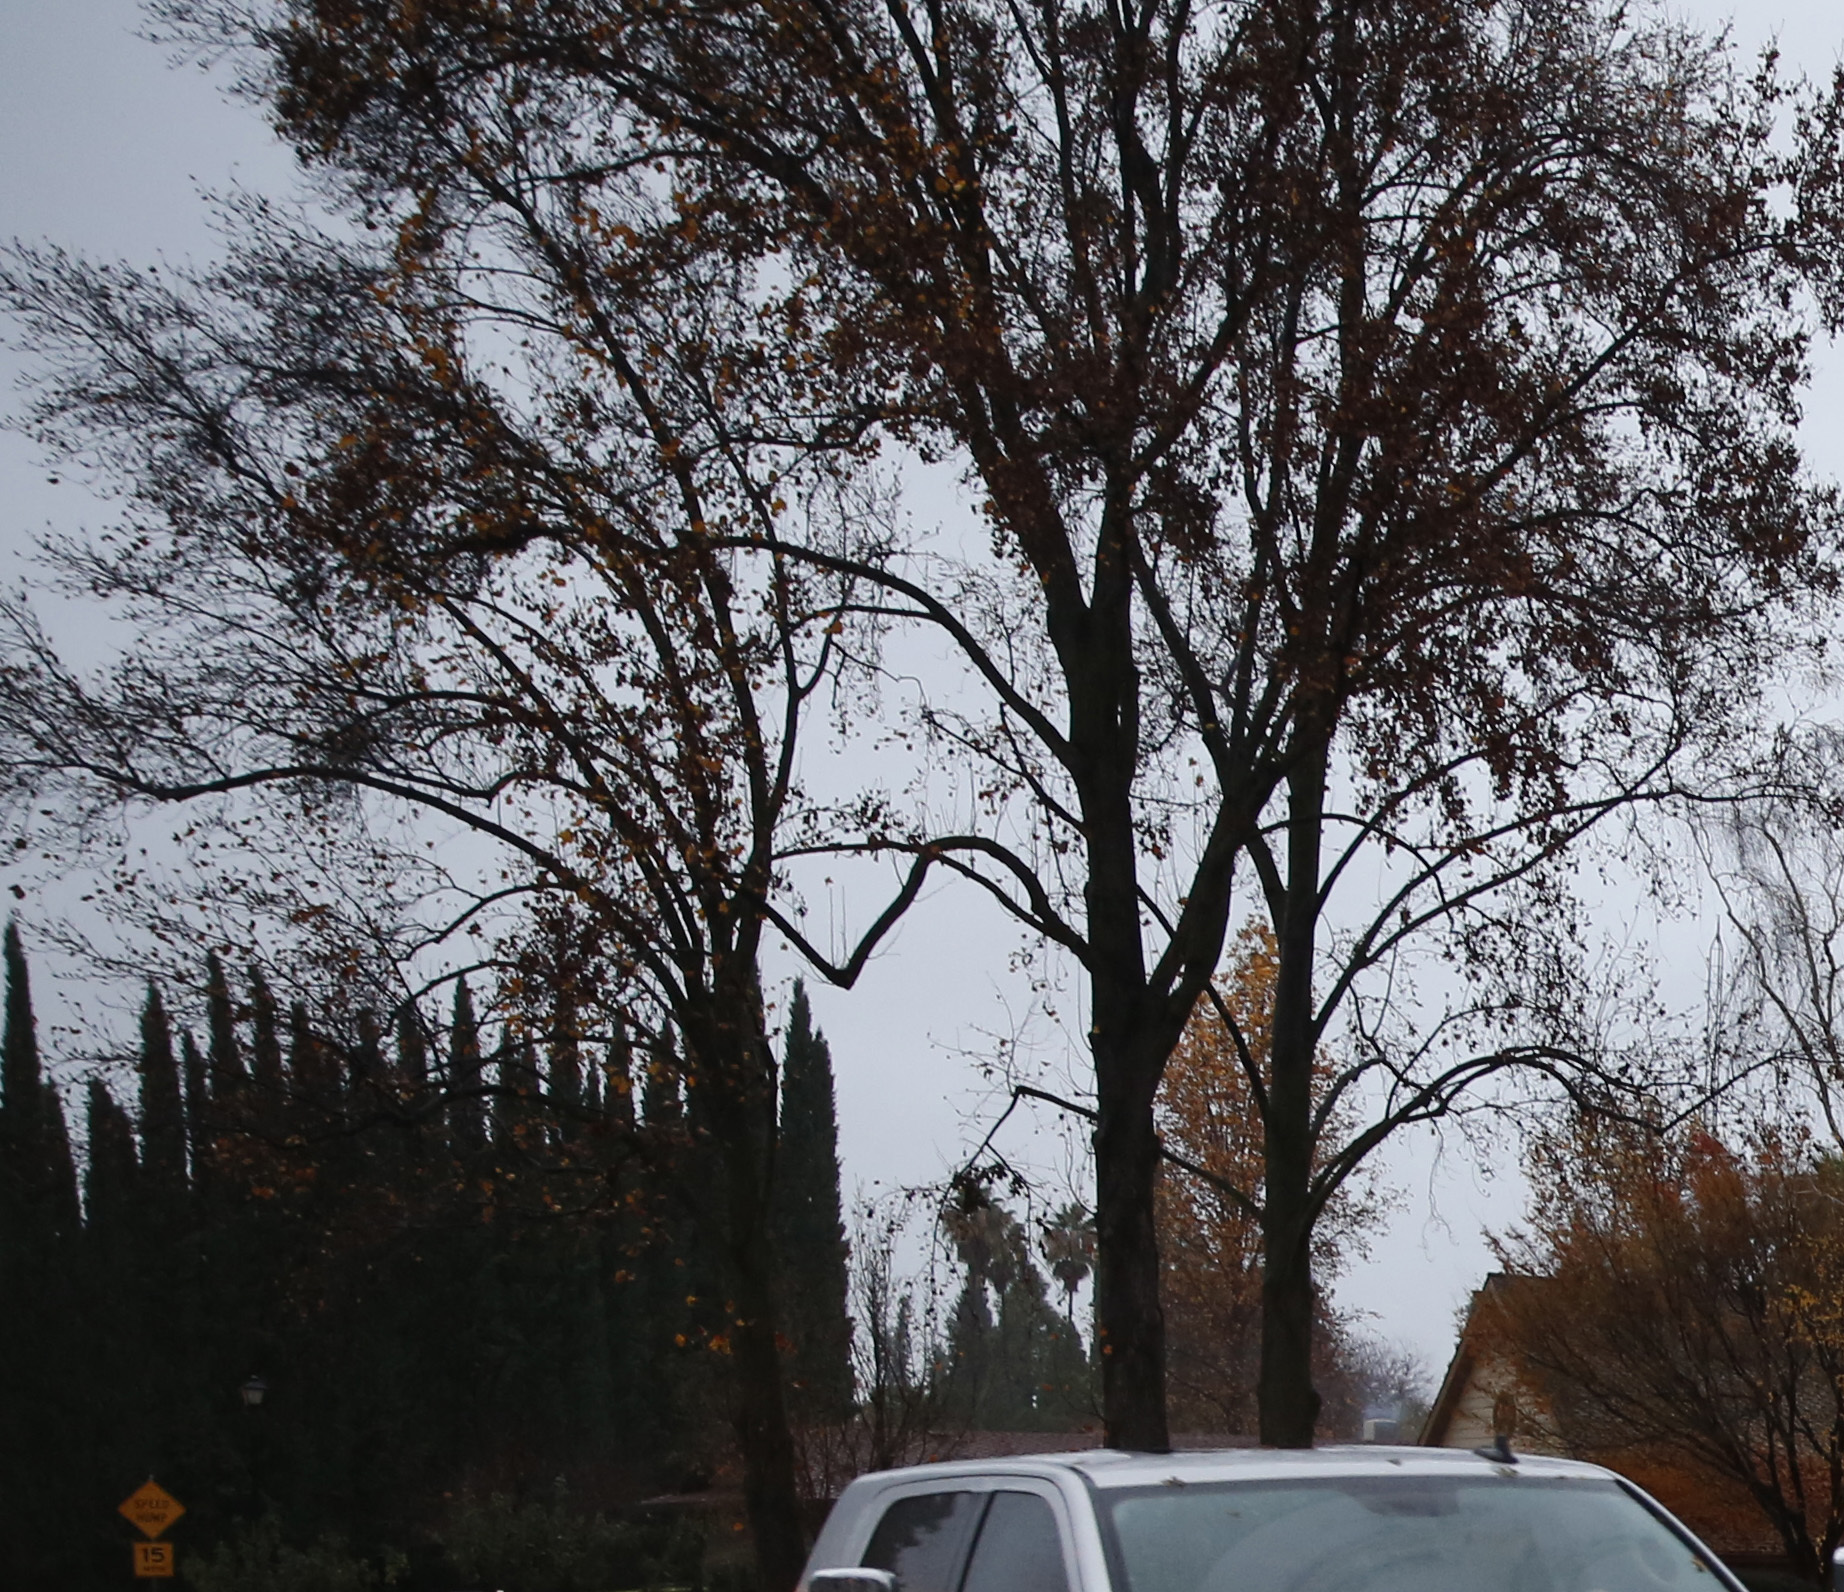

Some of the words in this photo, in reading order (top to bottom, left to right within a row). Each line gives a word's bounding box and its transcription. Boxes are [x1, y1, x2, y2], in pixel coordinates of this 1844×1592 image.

[134, 1497, 168, 1509] SPEED
[135, 1511, 166, 1523] HUMP
[143, 1546, 165, 1562] 15
